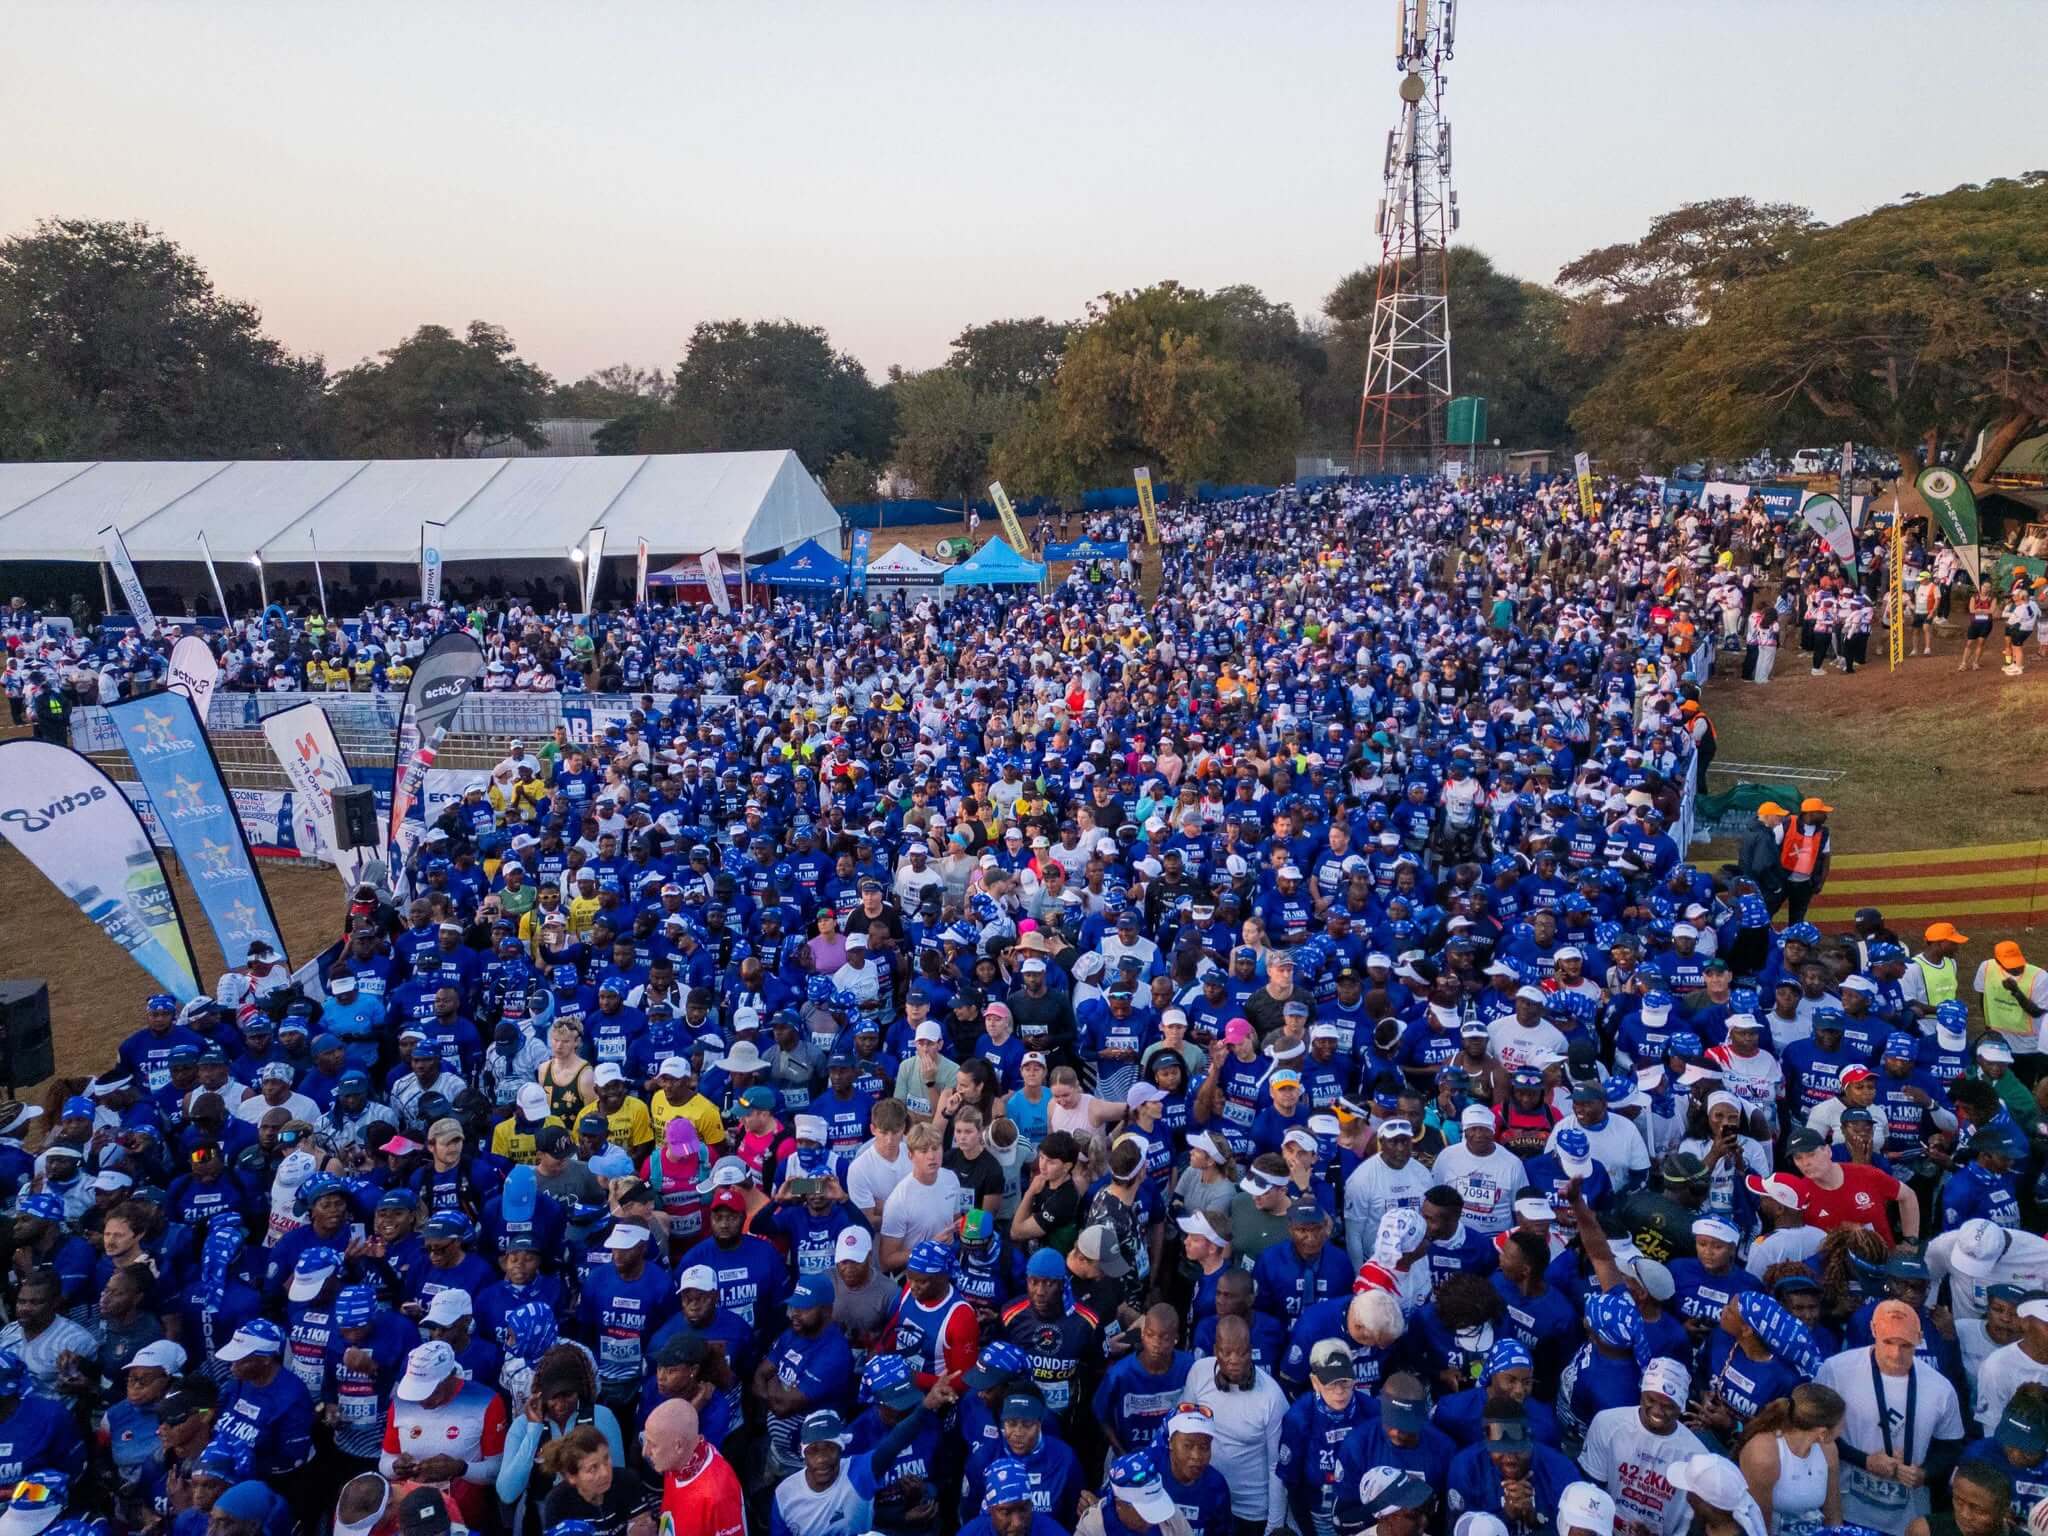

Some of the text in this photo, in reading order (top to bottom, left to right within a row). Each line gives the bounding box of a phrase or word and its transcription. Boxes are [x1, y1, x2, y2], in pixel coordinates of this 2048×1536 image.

[172, 668, 209, 694] activ8
[425, 678, 466, 699] activ8
[1671, 975, 1705, 983] 21.1KM
[413, 1006, 434, 1014] 21.1
[140, 1060, 169, 1072] 21.1K
[1930, 1064, 1961, 1076] 21.1K
[829, 1124, 863, 1135] 21.1KM
[1463, 1187, 1490, 1200] 7094
[805, 1256, 832, 1266] 1578
[720, 1283, 758, 1301] 1.1KM
[1682, 1297, 1723, 1320] 21.1K
[602, 1311, 646, 1326] 21.1KM
[290, 1325, 330, 1342] 21.1KM
[217, 1411, 260, 1442] 21.1KM
[885, 1458, 927, 1484] 1.1KM
[1618, 1461, 1677, 1496] 42.2KM
